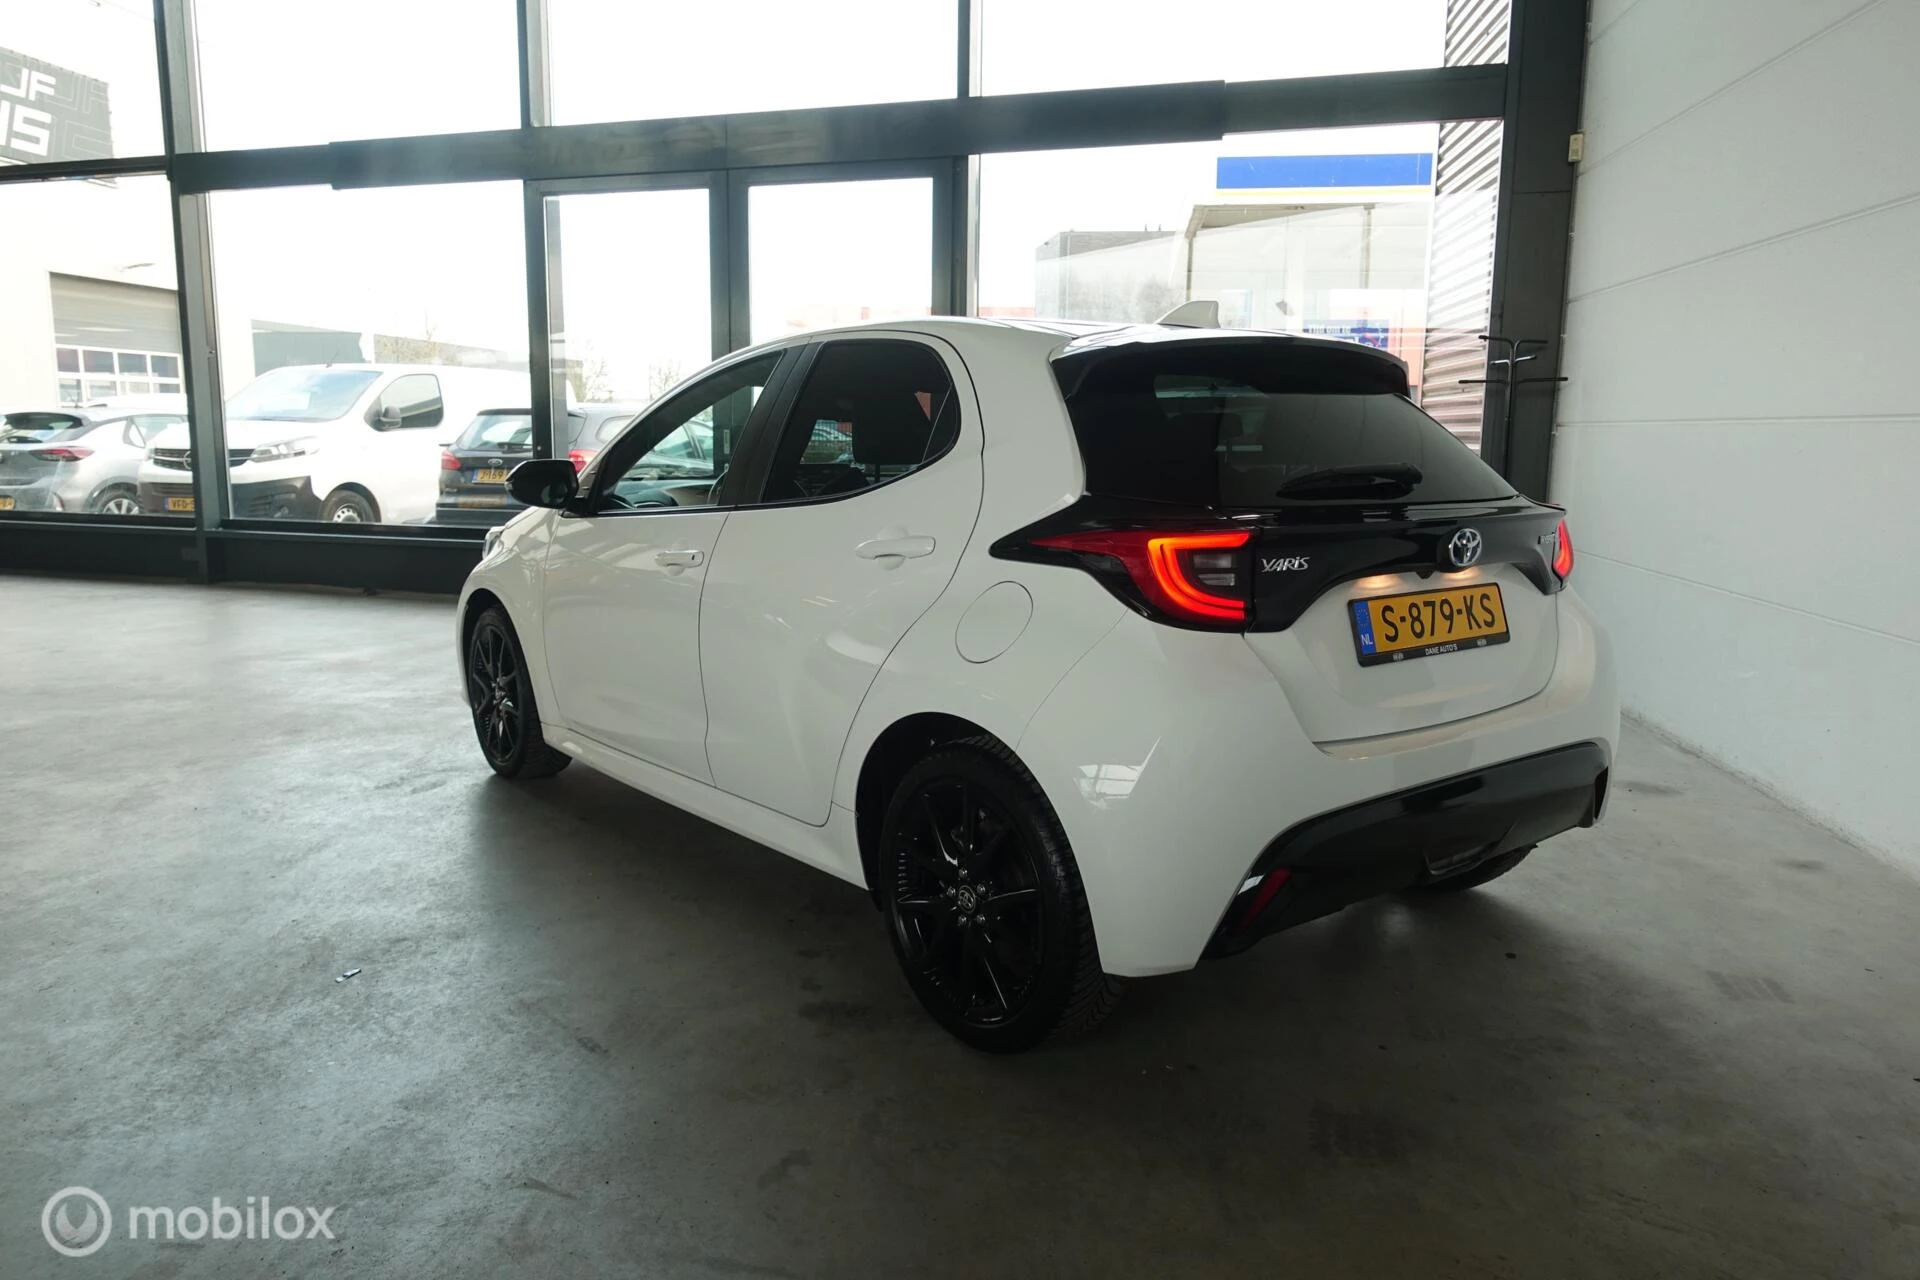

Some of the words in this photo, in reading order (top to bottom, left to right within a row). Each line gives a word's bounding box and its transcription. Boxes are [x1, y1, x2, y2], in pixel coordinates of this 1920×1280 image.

[1381, 592, 1496, 643] S-879-KS
[1360, 633, 1374, 646] NL
[1425, 646, 1439, 656] DANE
